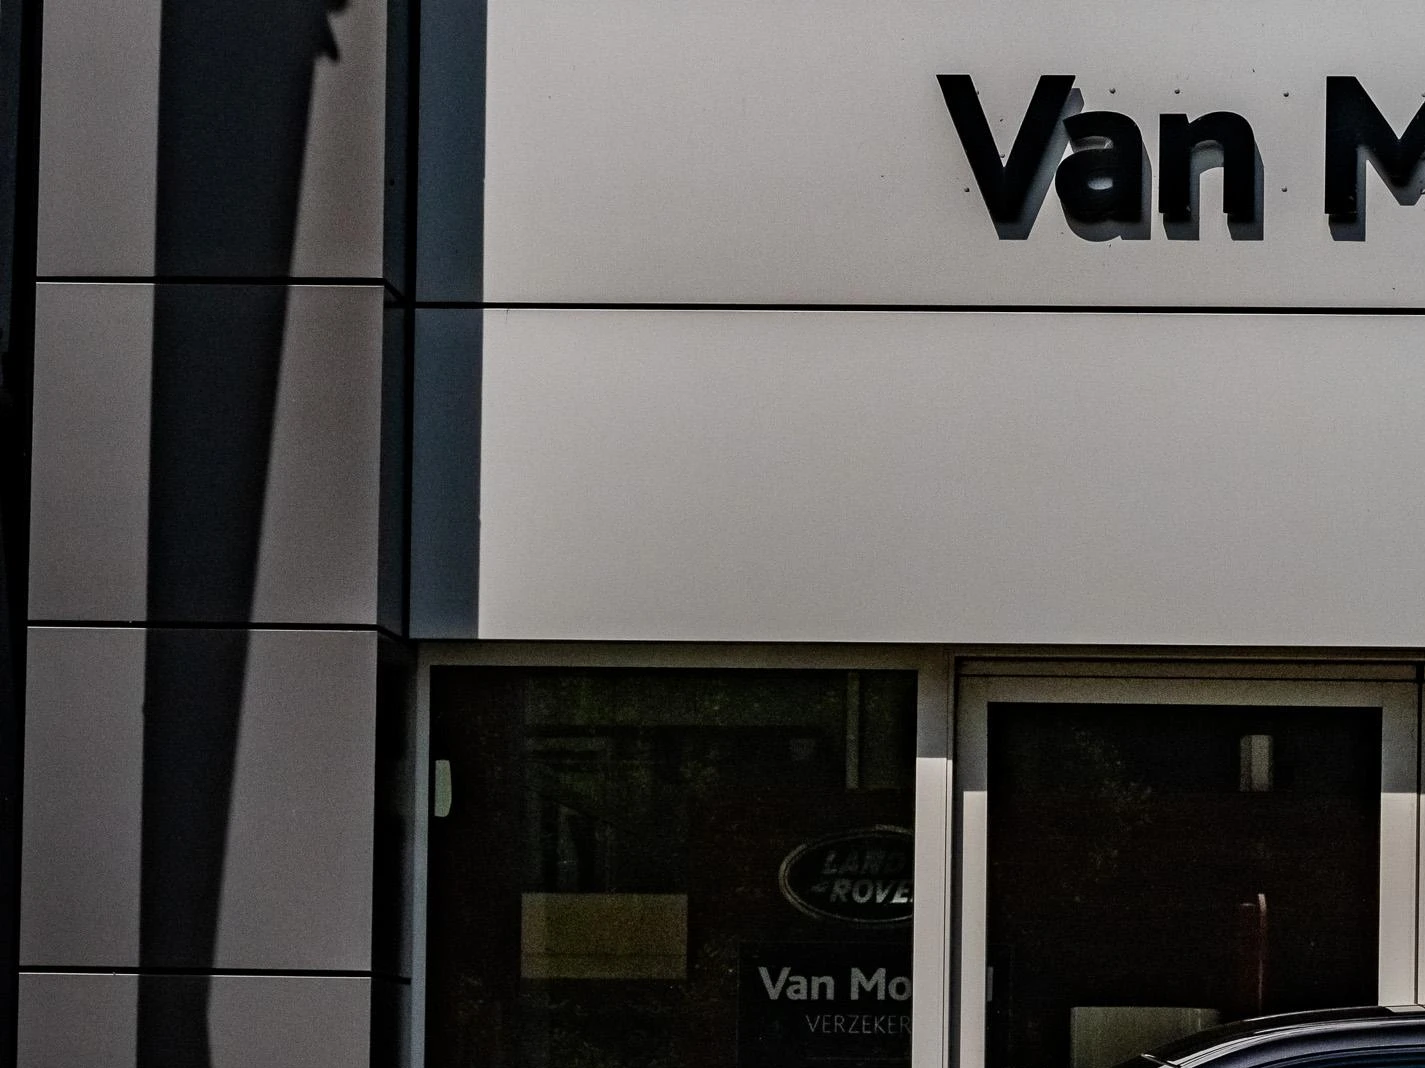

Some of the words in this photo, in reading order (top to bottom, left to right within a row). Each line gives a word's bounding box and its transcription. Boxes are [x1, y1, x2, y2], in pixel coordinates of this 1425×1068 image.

[936, 73, 1258, 221] Van
[830, 878, 914, 904] ROVE
[758, 966, 835, 1001] Van
[805, 1014, 912, 1034] VERZEKER
